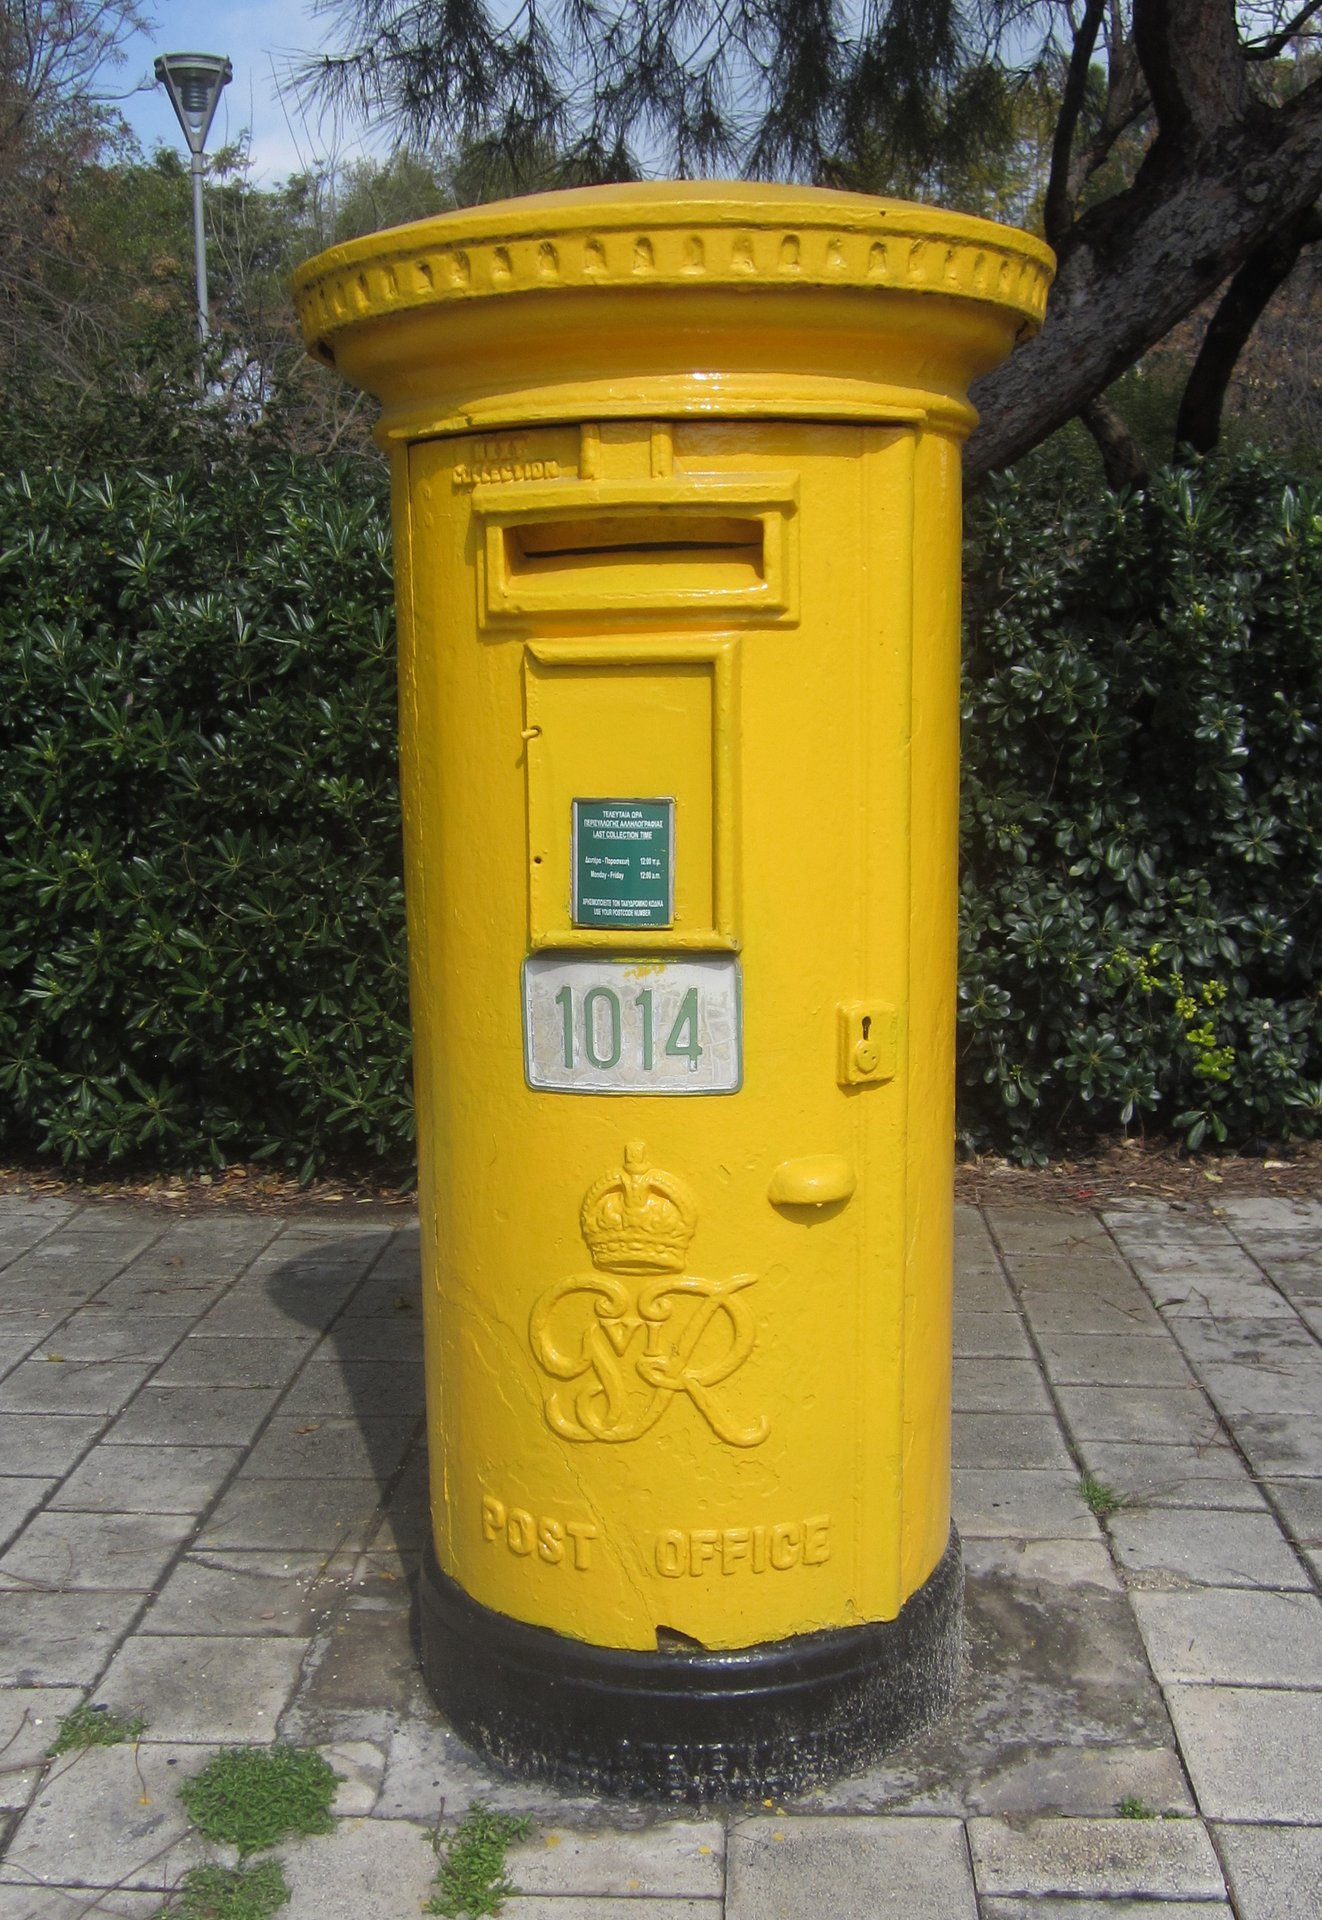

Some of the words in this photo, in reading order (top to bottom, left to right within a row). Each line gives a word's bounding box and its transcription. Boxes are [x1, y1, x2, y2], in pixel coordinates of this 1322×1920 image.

[603, 810, 630, 818] ΤΕΛΕΥΤΑΙΑ
[593, 830, 605, 839] LAST
[606, 831, 639, 839] COLLECTION
[640, 831, 653, 839] TIME
[640, 857, 651, 865] 12:00
[591, 870, 607, 880] Monday
[610, 871, 624, 880] Friday
[640, 871, 651, 879] 12:00
[612, 899, 620, 907] ΤΟΝ
[555, 986, 703, 1072] 1014
[482, 1494, 596, 1570] POST
[655, 1514, 832, 1578] OFFICE
